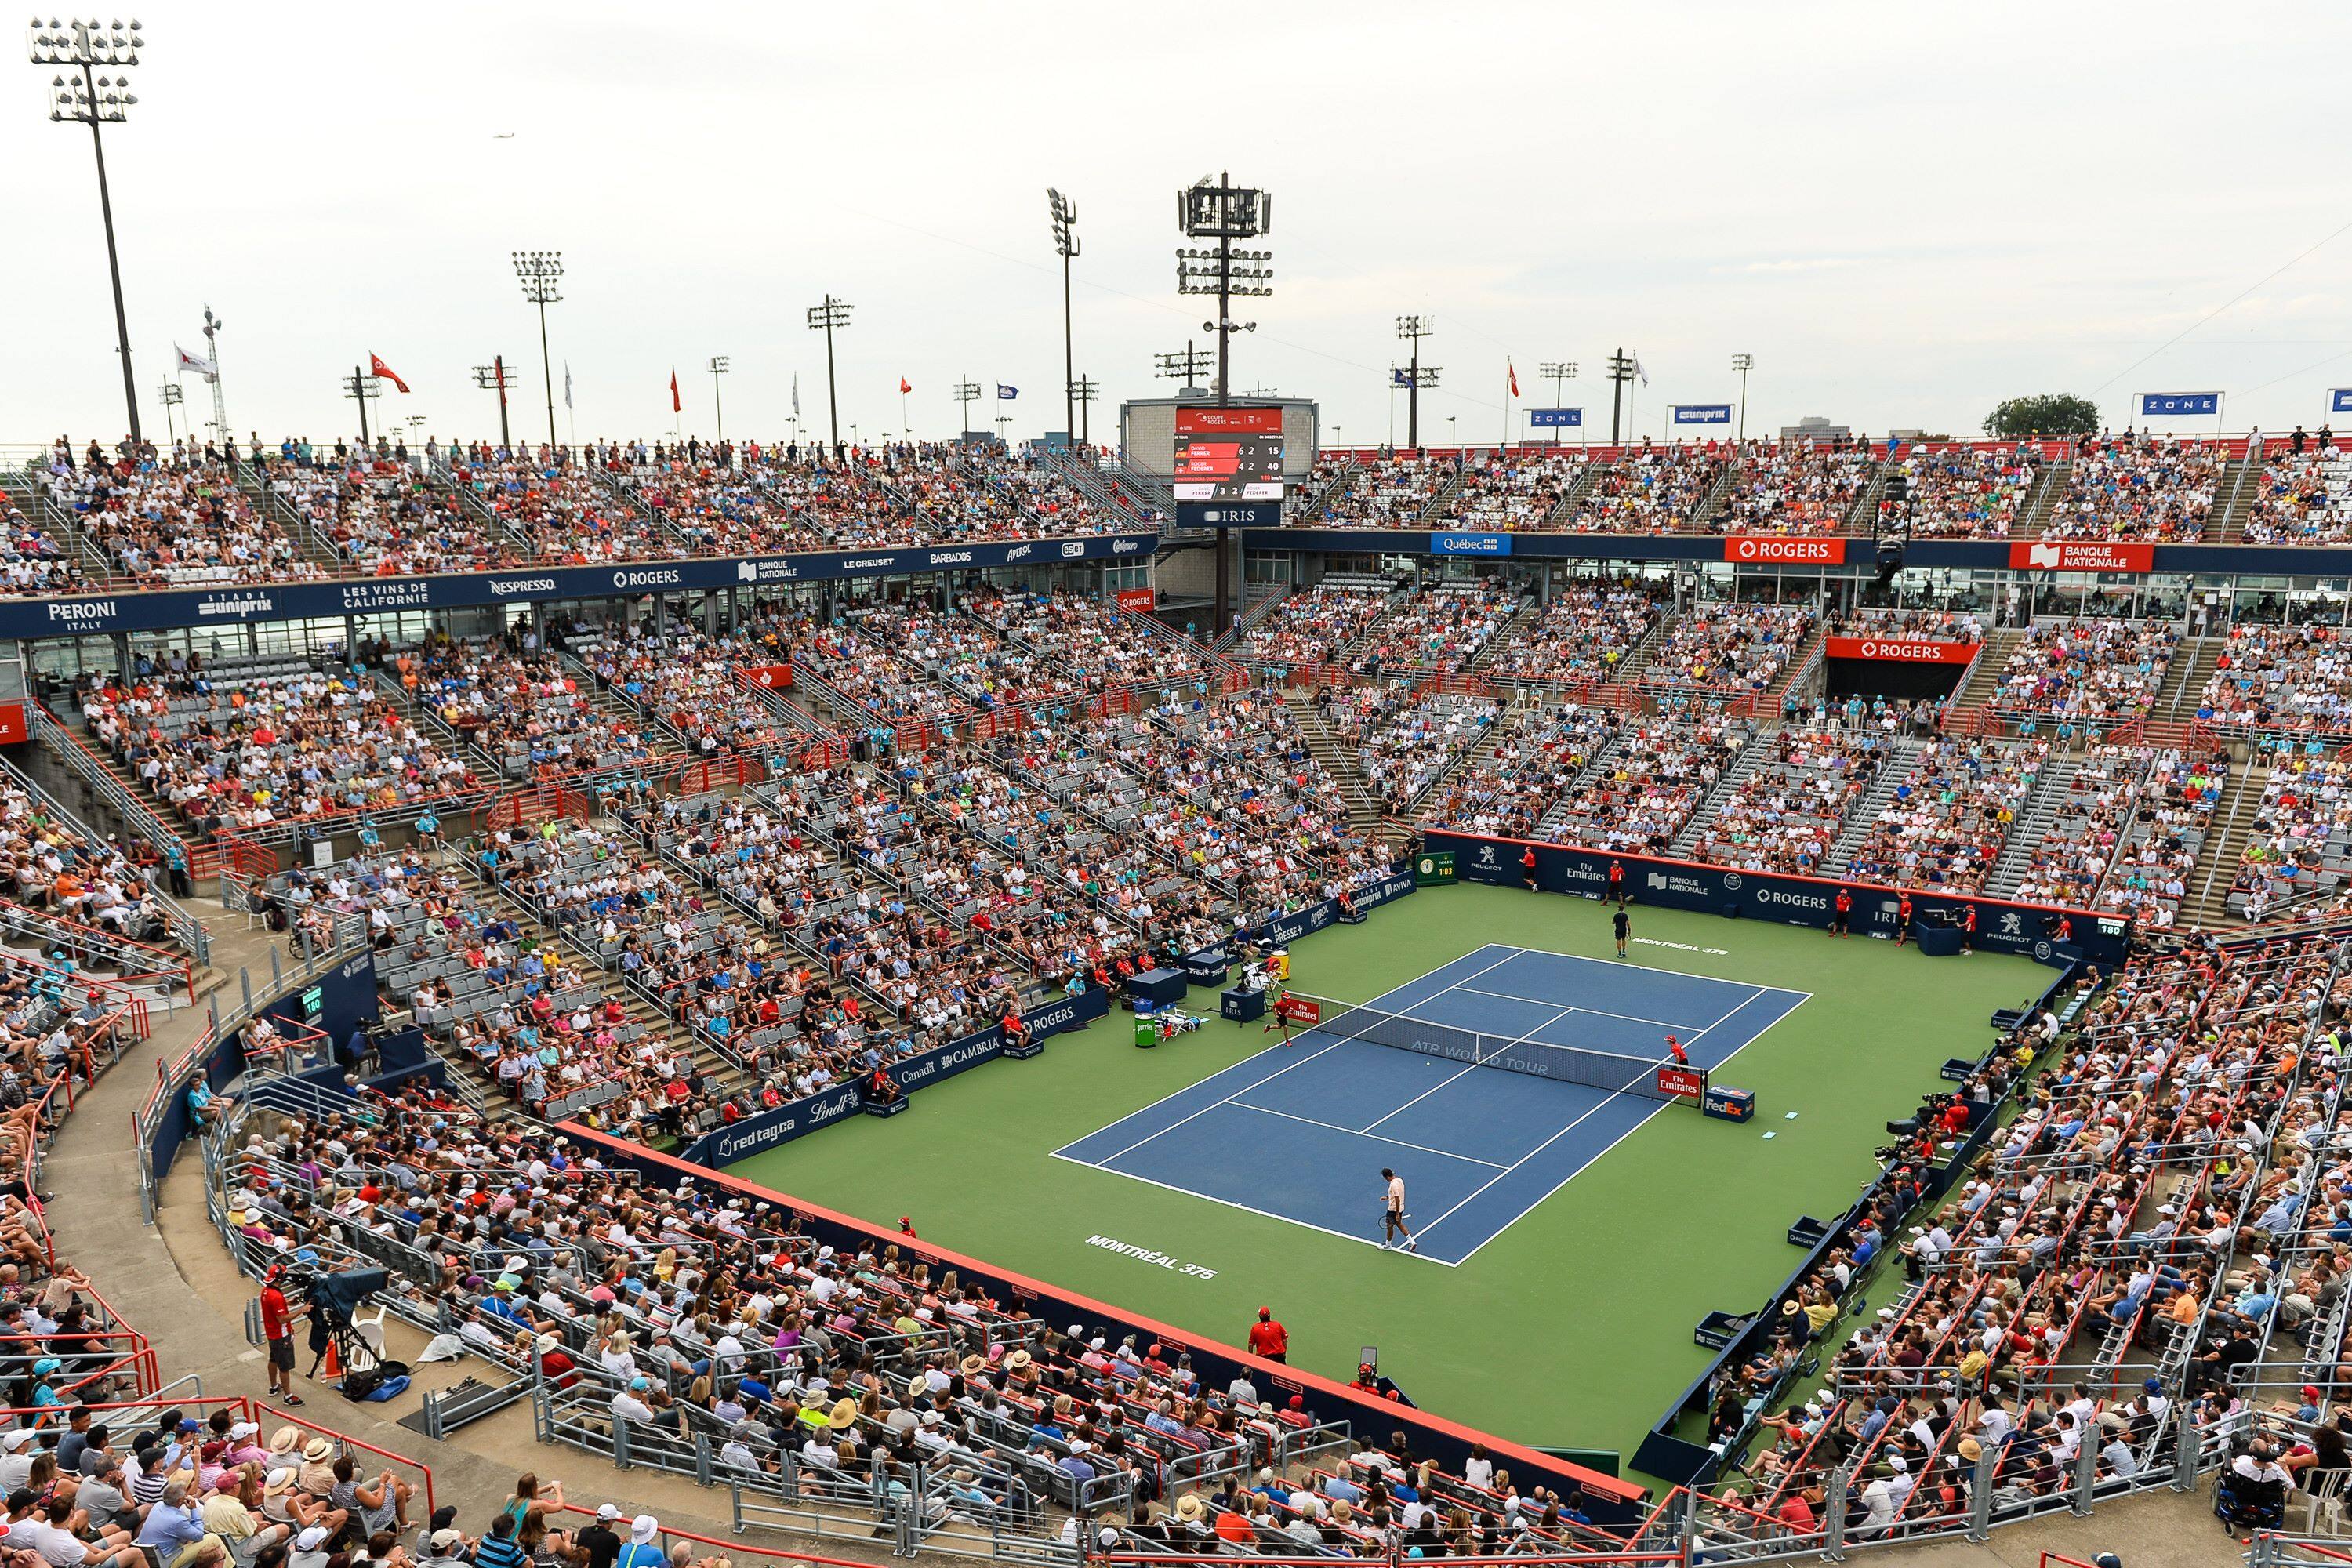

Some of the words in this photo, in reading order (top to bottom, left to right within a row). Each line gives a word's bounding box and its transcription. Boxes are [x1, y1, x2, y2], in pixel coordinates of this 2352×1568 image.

[2149, 401, 2211, 409] ZONE
[1238, 447, 1244, 456] 6
[1220, 487, 1225, 495] 3
[1222, 510, 1255, 521] IRIS
[1444, 538, 1483, 550] Québec
[1759, 543, 1828, 557] ROGERS
[931, 551, 971, 564] BARBADOS
[1007, 544, 1031, 562] APEROL
[2065, 546, 2111, 557] BANQUE
[759, 561, 787, 570] BANQUE
[856, 558, 895, 568] CREUSET
[2063, 557, 2127, 568] NATIONALE
[630, 569, 679, 585] ROGERS
[759, 568, 797, 579] NATIONALE
[343, 586, 368, 597] LES
[372, 584, 405, 596] VINS
[411, 583, 427, 592] DE
[488, 579, 555, 596] NESPRESSO
[208, 591, 265, 602] STADE
[344, 593, 429, 608] CALIFORNIE
[1128, 596, 1150, 606] ROGERS
[48, 601, 117, 620] PERONI
[215, 597, 272, 618] uniprix
[67, 620, 101, 630] ITALY
[1879, 644, 1941, 659] ROGERS
[1439, 867, 1452, 876] 1:03
[1471, 862, 1502, 871] PEUGEOT
[1581, 862, 1592, 872] Fly
[1567, 868, 1606, 882] Emirates
[1669, 876, 1698, 886] BANQUE
[1393, 879, 1411, 892] AVIVA
[1669, 884, 1708, 895] NATIONALE
[1773, 892, 1827, 909] ROGERS
[1875, 911, 1896, 924] IRI
[1272, 923, 1283, 933] LA
[2101, 925, 2121, 935] 180
[1632, 937, 1700, 952] MONTRÉAL
[1987, 933, 2031, 943] PEUGEOT
[307, 998, 321, 1013] 180
[1225, 1007, 1242, 1016] IRIS
[1033, 1006, 1073, 1032] ROGERS
[1289, 1007, 1317, 1020] Emirates
[953, 1036, 1000, 1064] CAMBRIA
[1411, 1040, 1441, 1053] ATP
[1445, 1046, 1501, 1065] WORLD
[1507, 1058, 1548, 1075] TOUR
[902, 1062, 935, 1083] Canada
[1660, 1080, 1697, 1094] Emirates
[1711, 1086, 1748, 1097] FedEx
[808, 1094, 848, 1124] Lindt
[1705, 1098, 1743, 1116] FedEx
[1085, 1234, 1178, 1269] MONTRÉAL
[1178, 1263, 1218, 1279] 375
